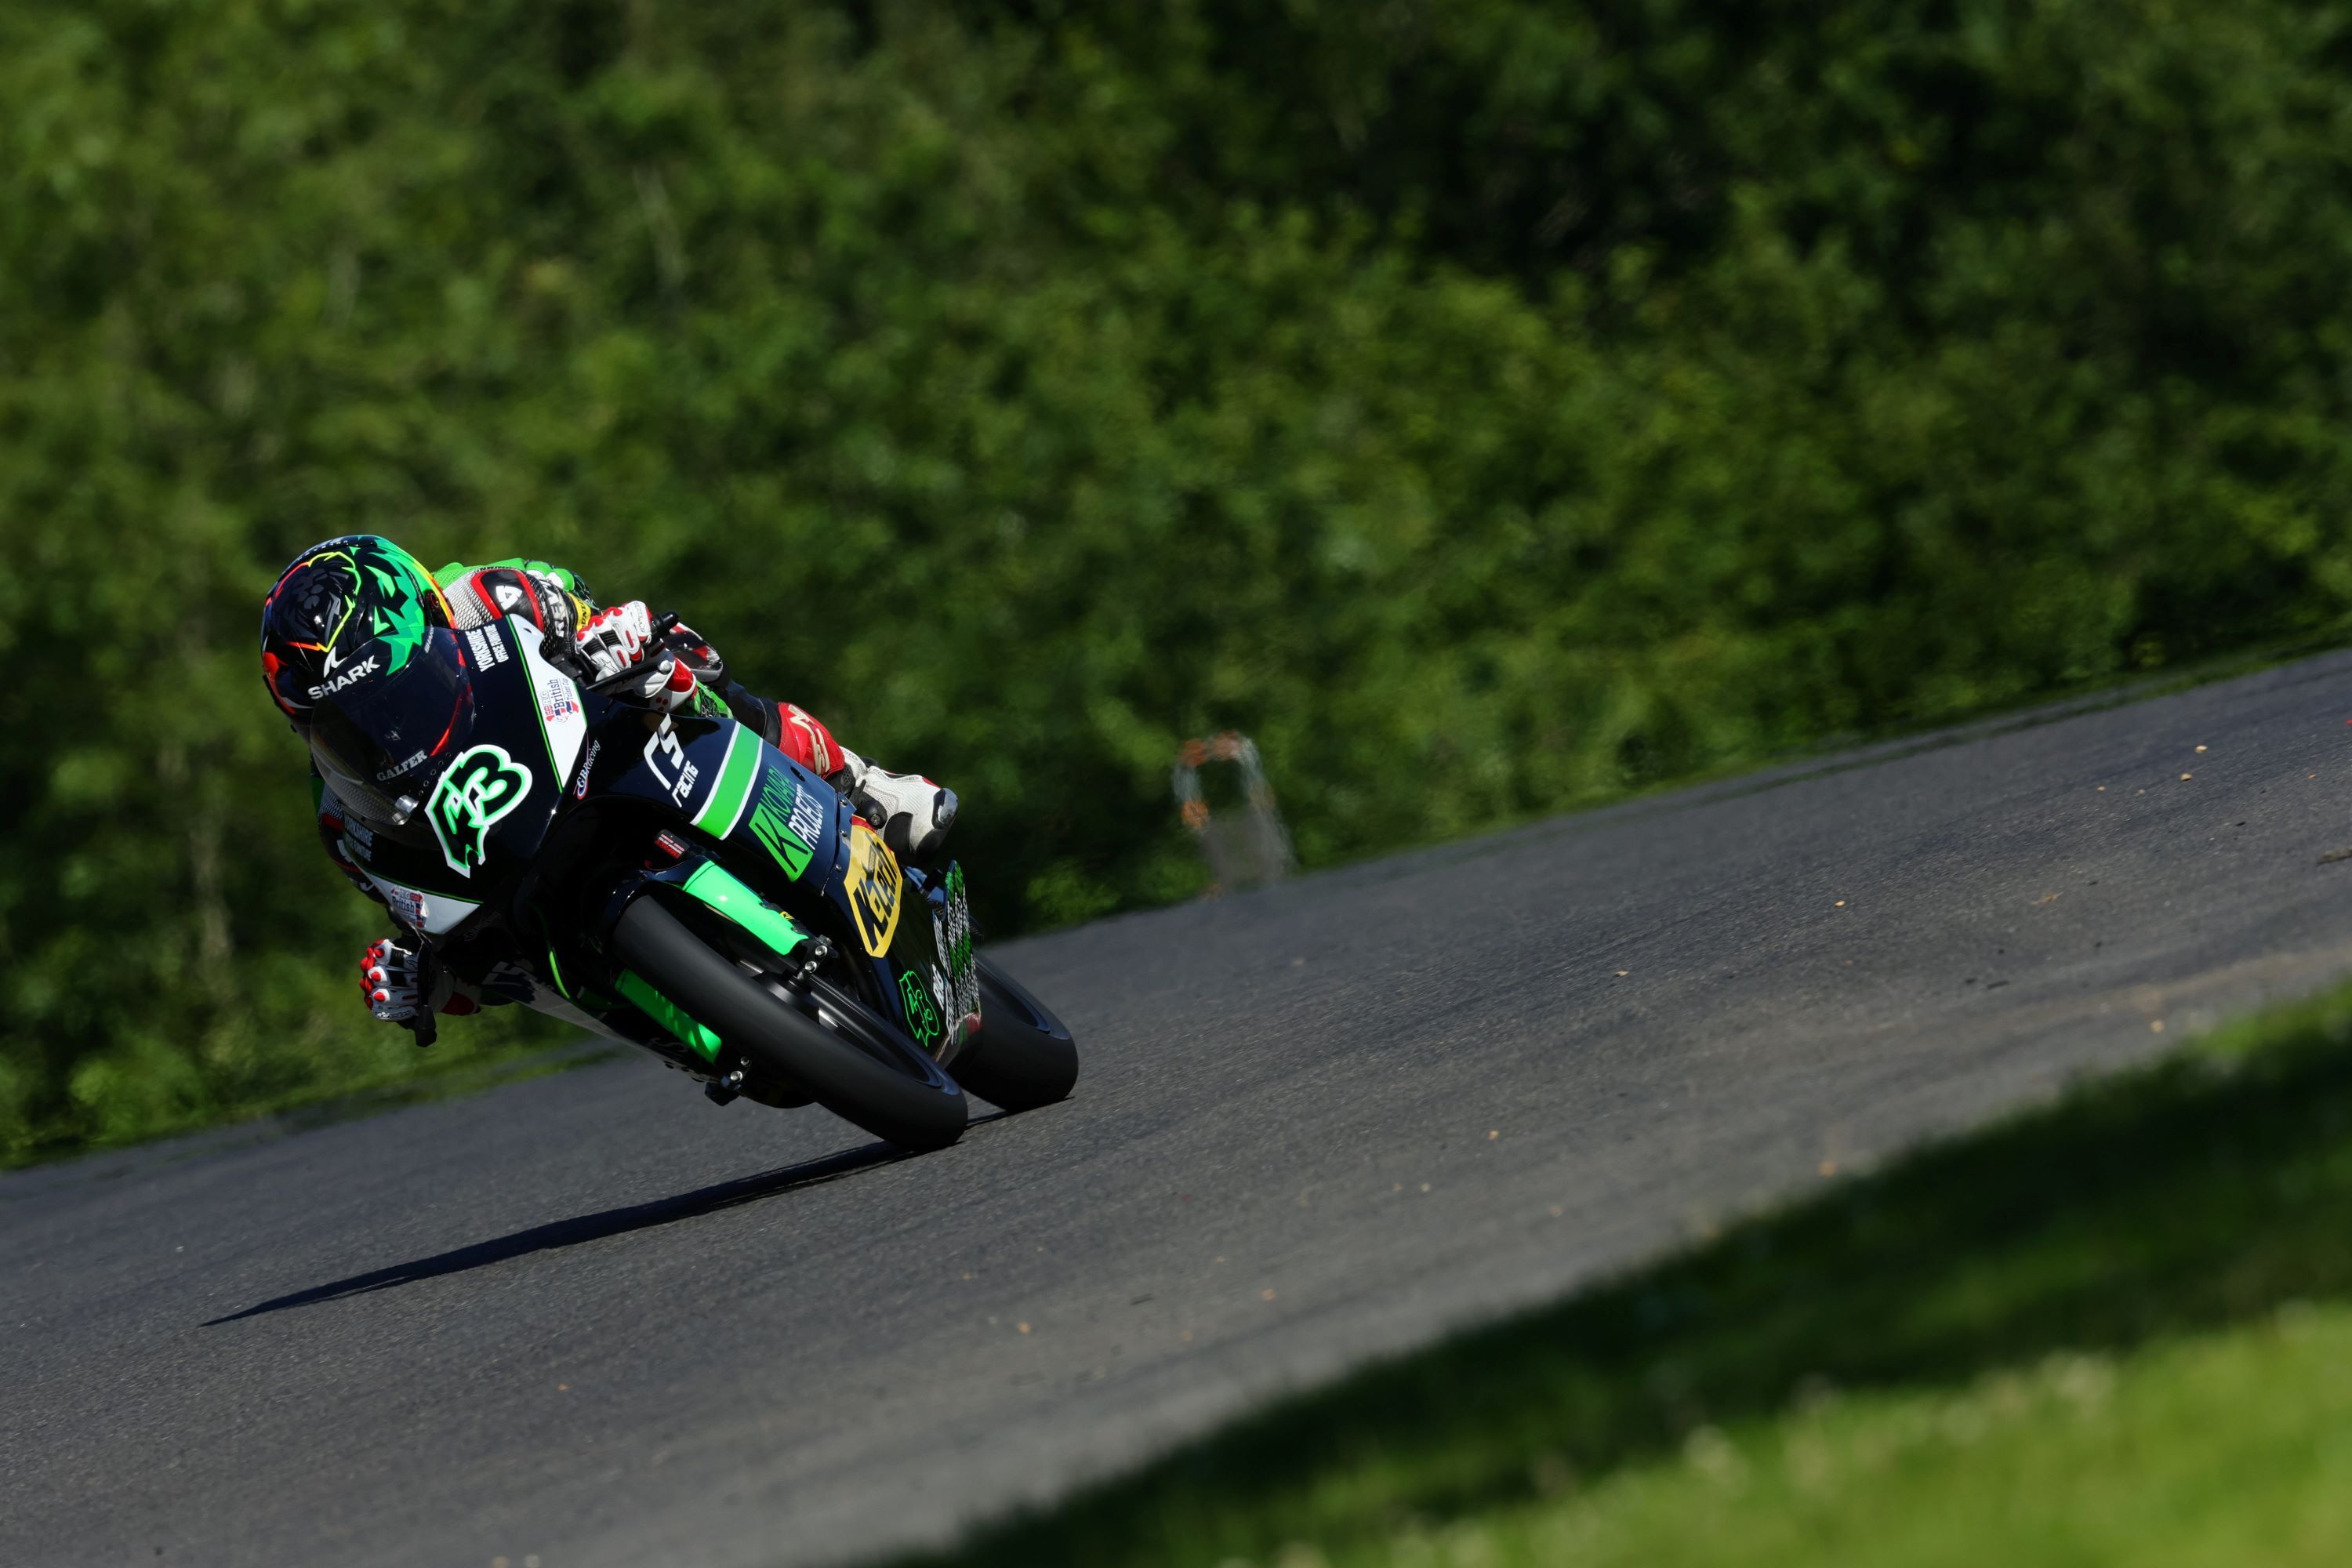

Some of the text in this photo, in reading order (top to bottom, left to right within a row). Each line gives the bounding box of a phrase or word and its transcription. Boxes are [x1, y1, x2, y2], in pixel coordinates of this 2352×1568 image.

[464, 628, 495, 673] YORKSHIRE
[492, 644, 510, 663] OFFICE
[307, 655, 381, 700] SHARK
[547, 679, 565, 710] British
[376, 750, 428, 782] GALFER
[672, 760, 699, 808] racing
[760, 764, 797, 823] KOVARA
[788, 783, 824, 851] PROJECTS
